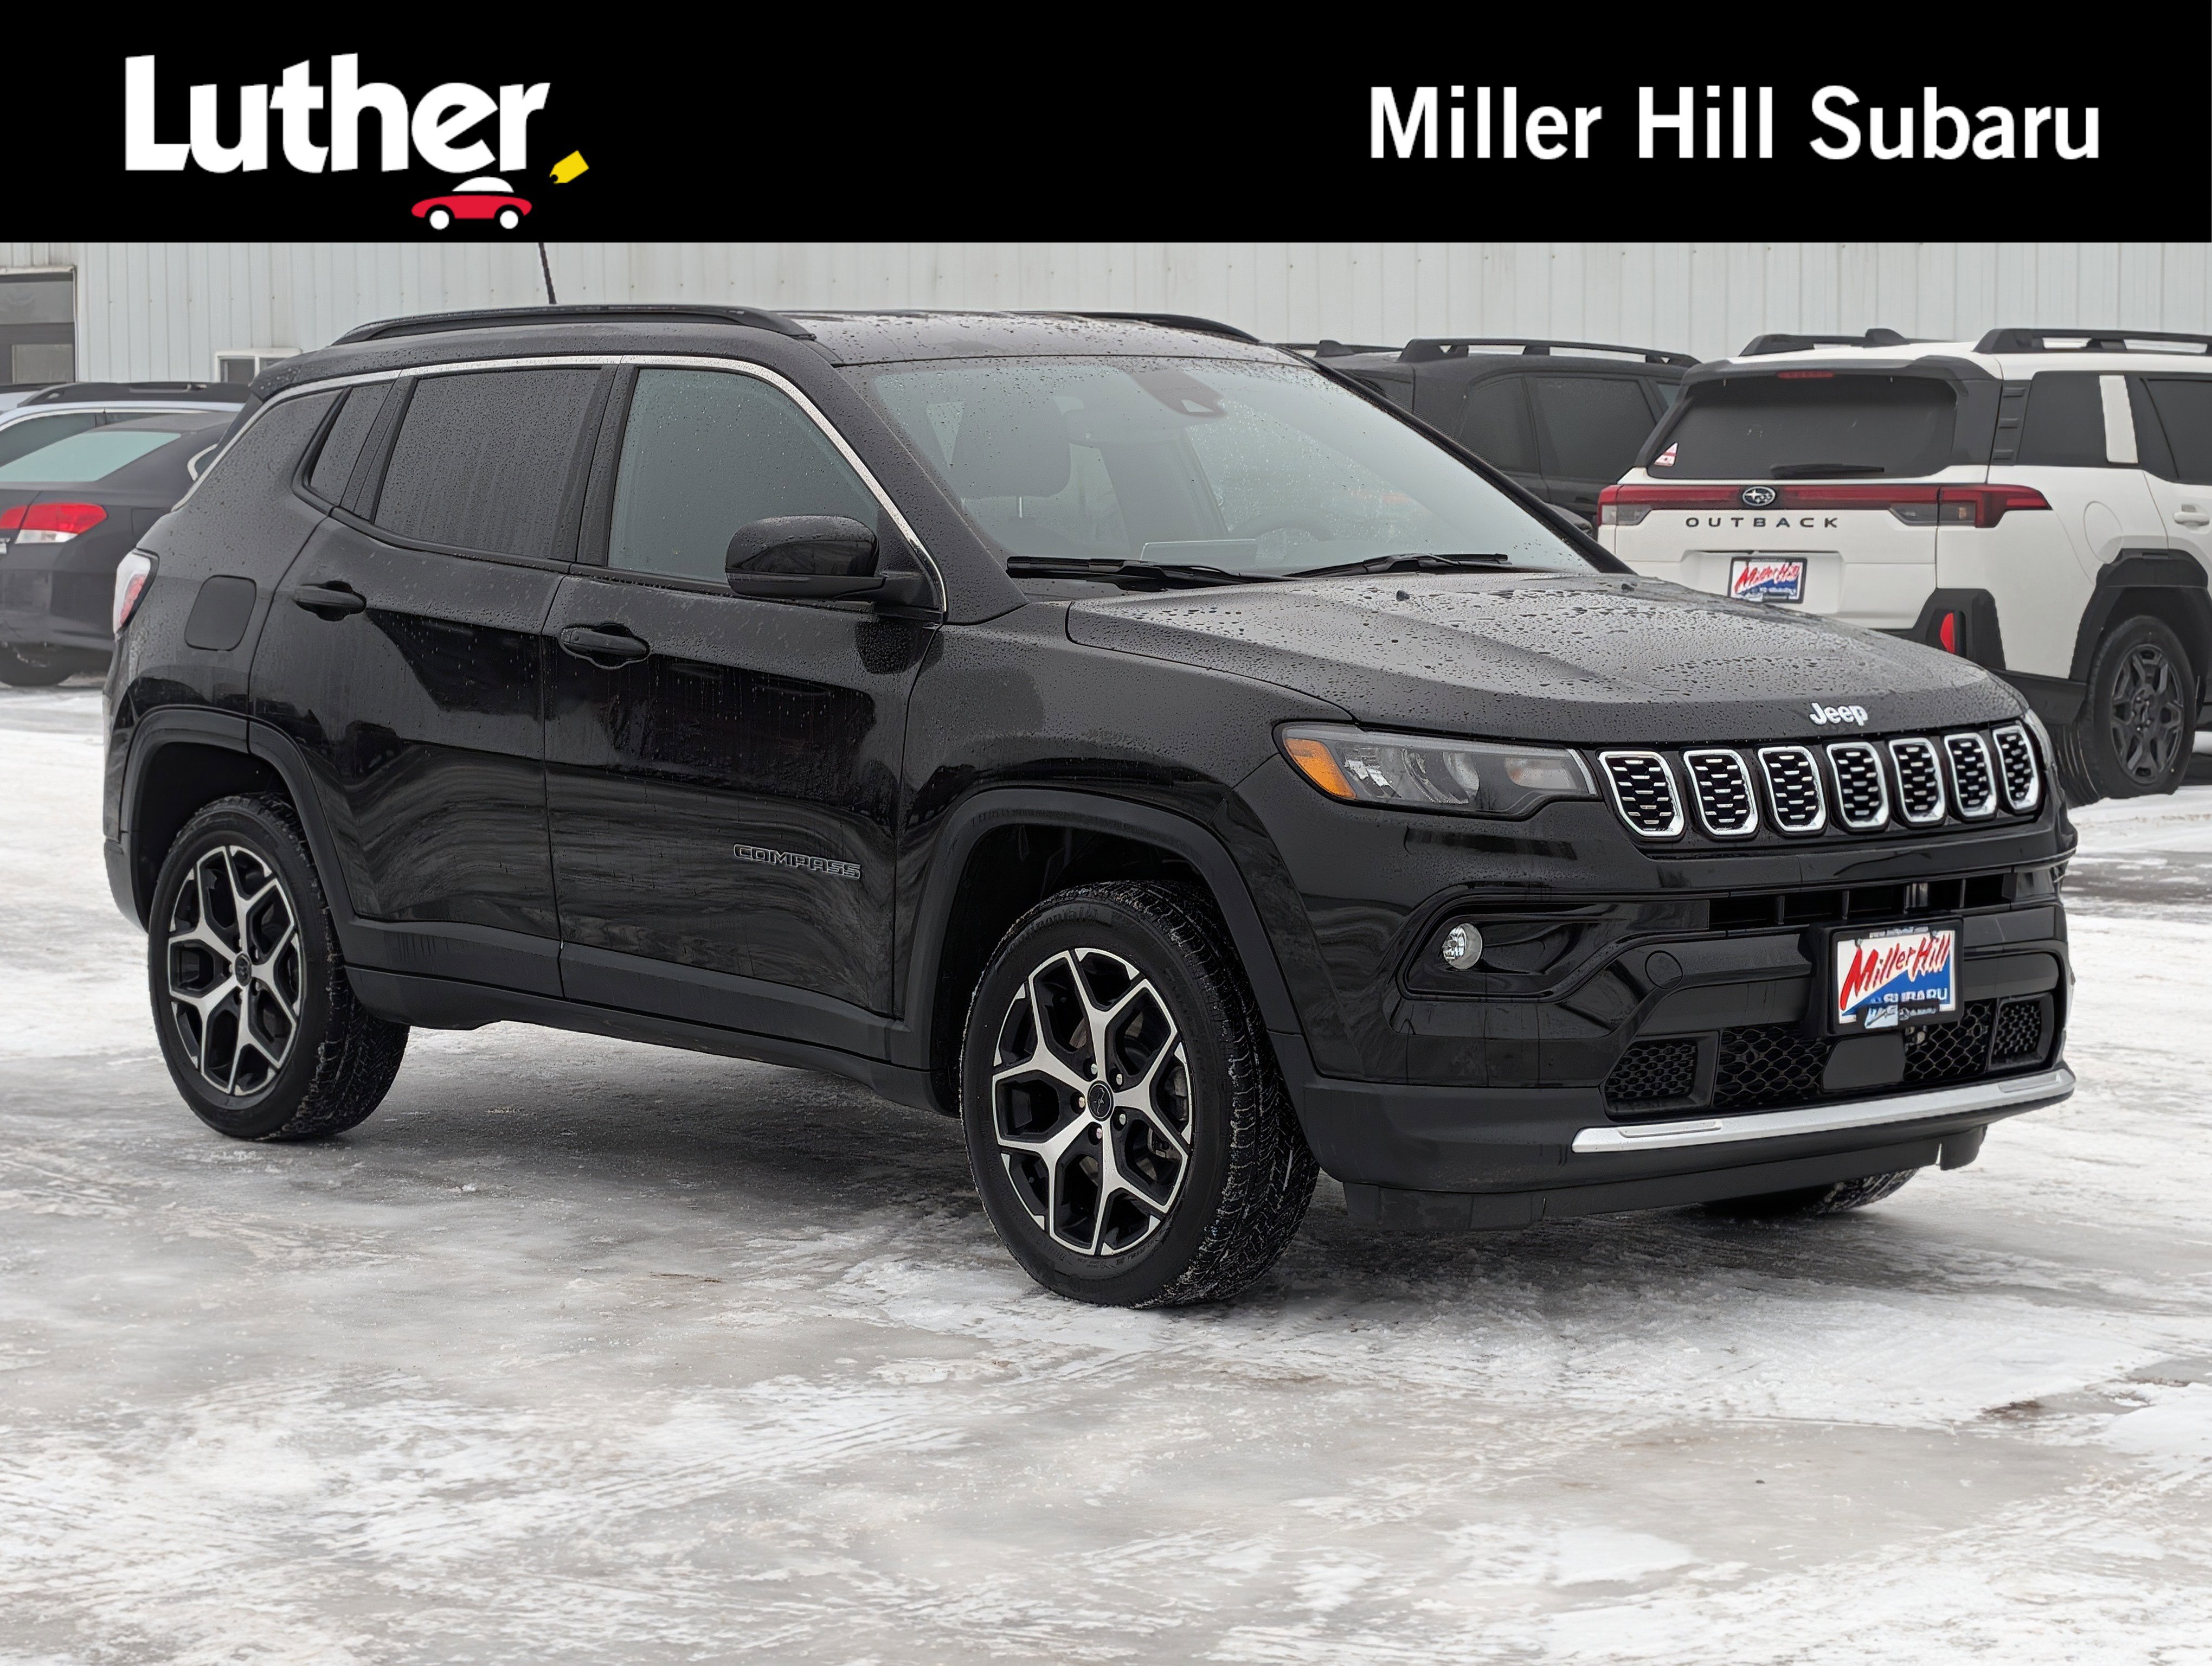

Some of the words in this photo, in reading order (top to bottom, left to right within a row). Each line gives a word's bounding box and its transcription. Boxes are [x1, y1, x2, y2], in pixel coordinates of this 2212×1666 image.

[1685, 517, 1838, 528] OUTBACK
[1809, 702, 1869, 727] Jeep
[733, 843, 862, 880] COMPASS
[1840, 942, 1916, 1011] Miller
[1912, 933, 1951, 978] Hill
[1883, 987, 1948, 1003] SUBARU
